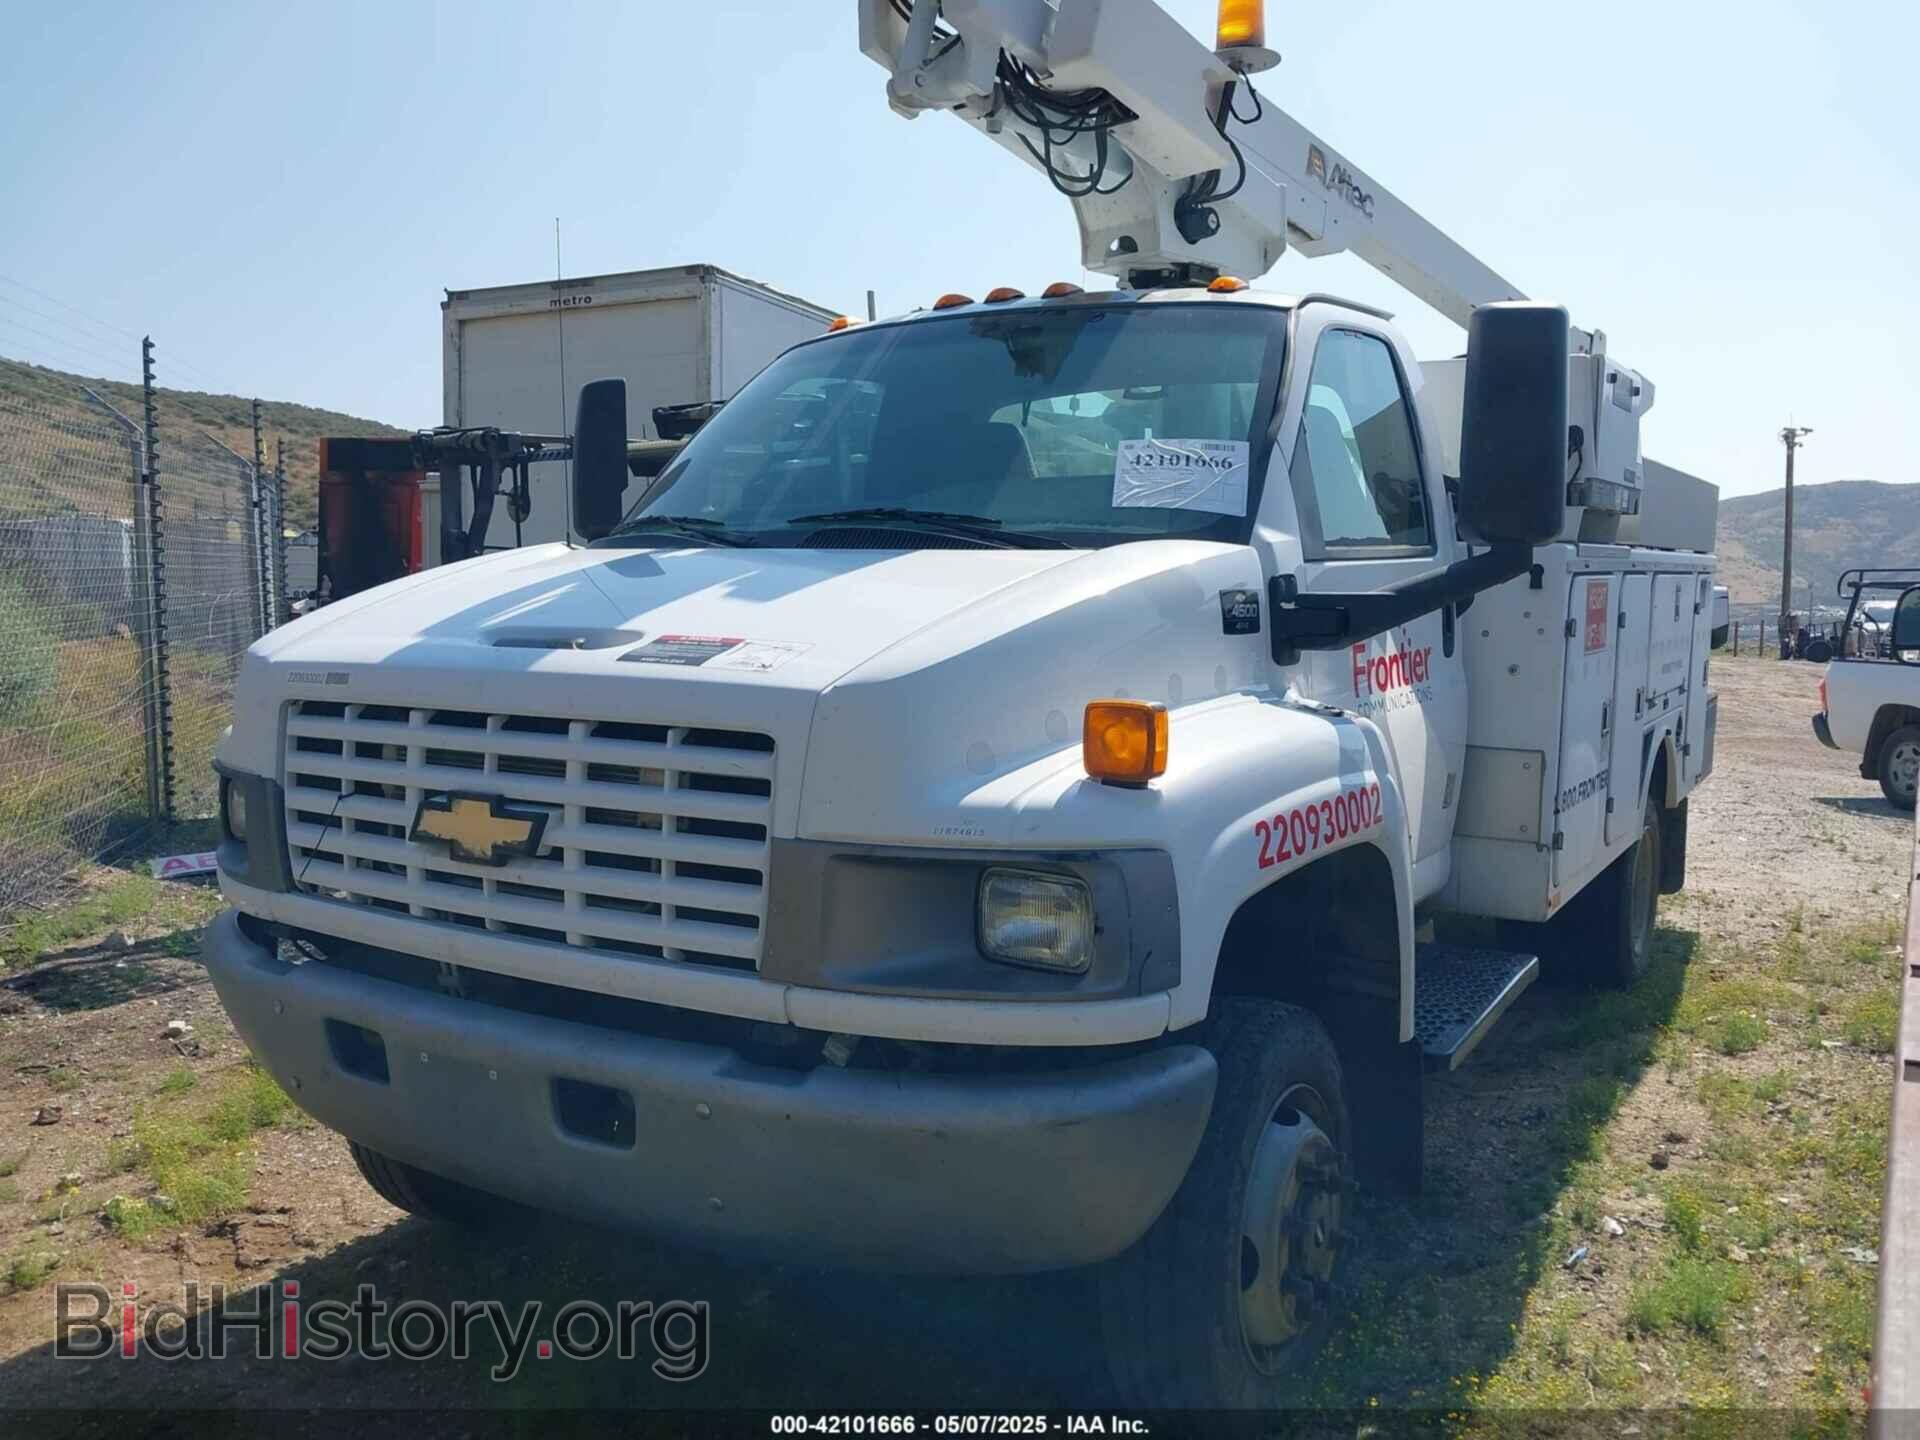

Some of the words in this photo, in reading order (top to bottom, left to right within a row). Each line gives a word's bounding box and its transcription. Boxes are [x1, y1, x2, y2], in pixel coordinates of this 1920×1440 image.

[1326, 163, 1375, 219] Altec
[550, 295, 592, 307] metro
[1130, 453, 1233, 469] 42101666
[1353, 638, 1431, 698] Frontier
[1255, 782, 1384, 870] 220930002
